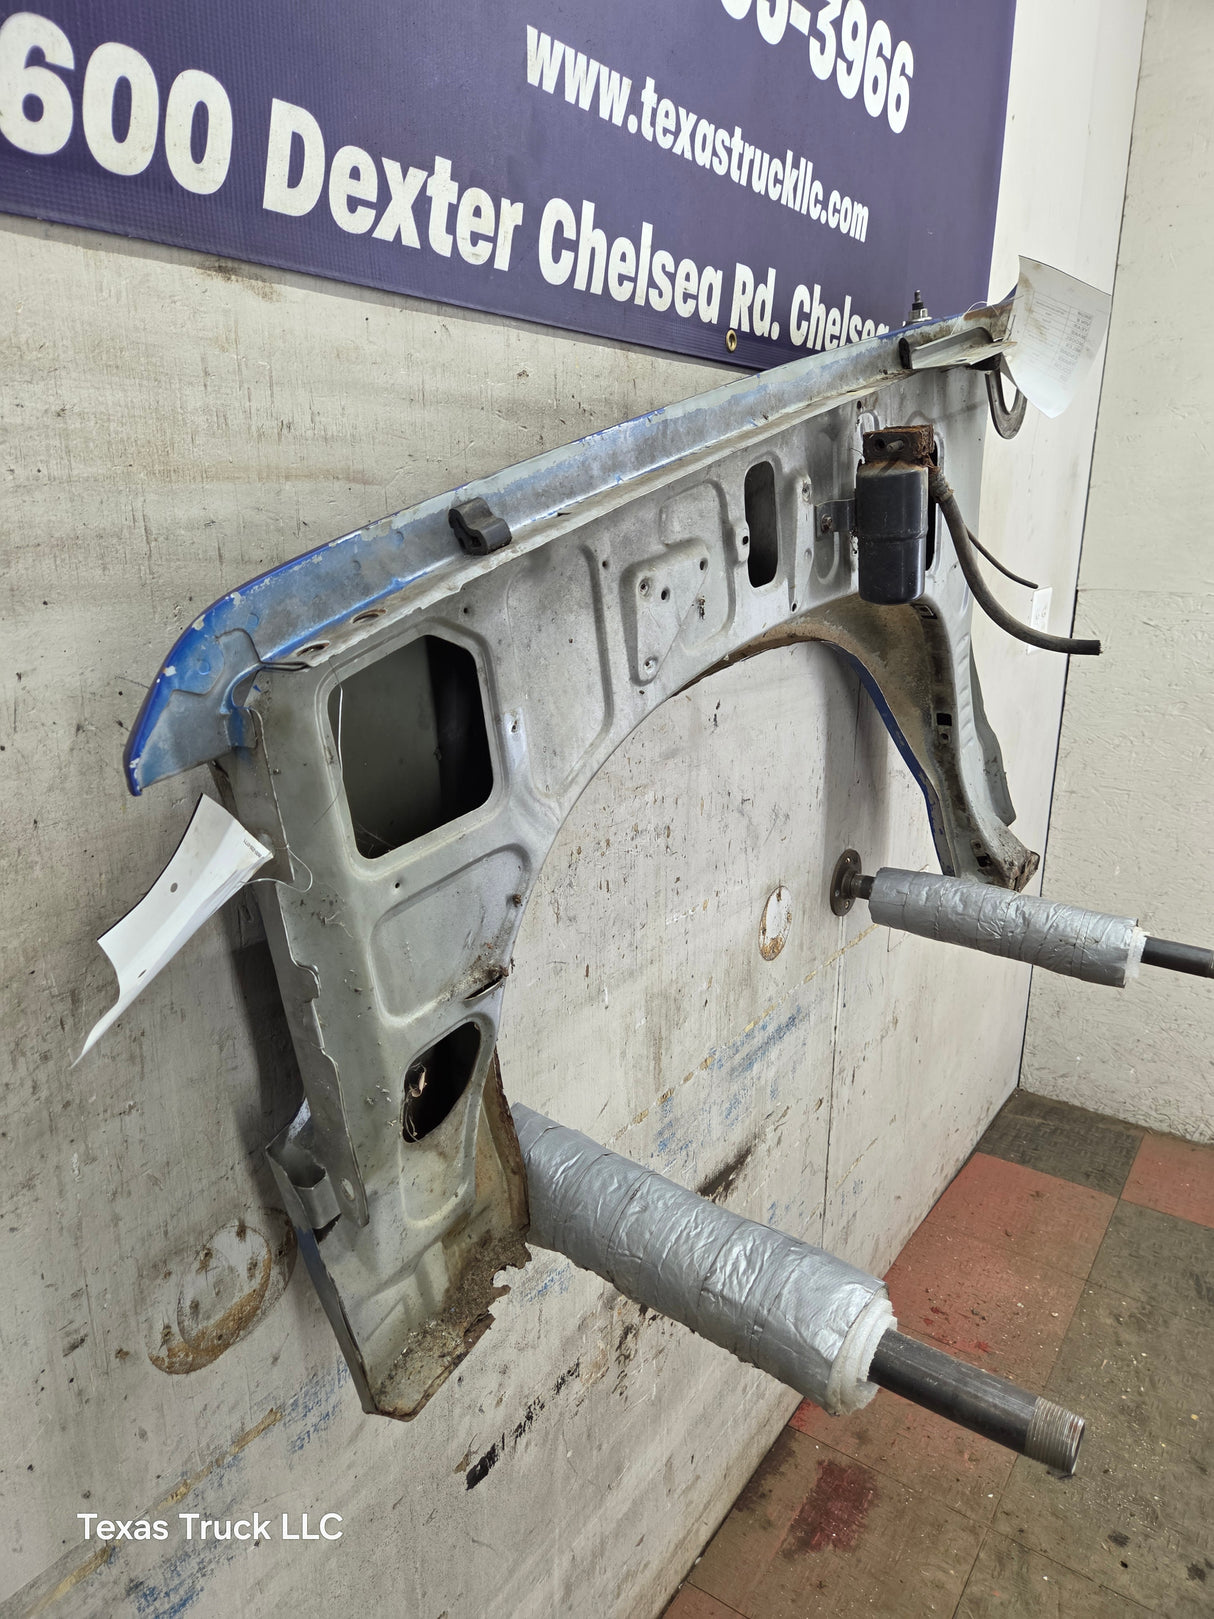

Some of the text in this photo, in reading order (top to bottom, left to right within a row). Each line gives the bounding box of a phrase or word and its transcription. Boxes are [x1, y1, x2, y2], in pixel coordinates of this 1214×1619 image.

[263, 98, 523, 271] Dexter
[538, 197, 723, 325] Chelsea
[729, 262, 780, 341] Rd.
[526, 25, 869, 243] www.texastruckllc.com
